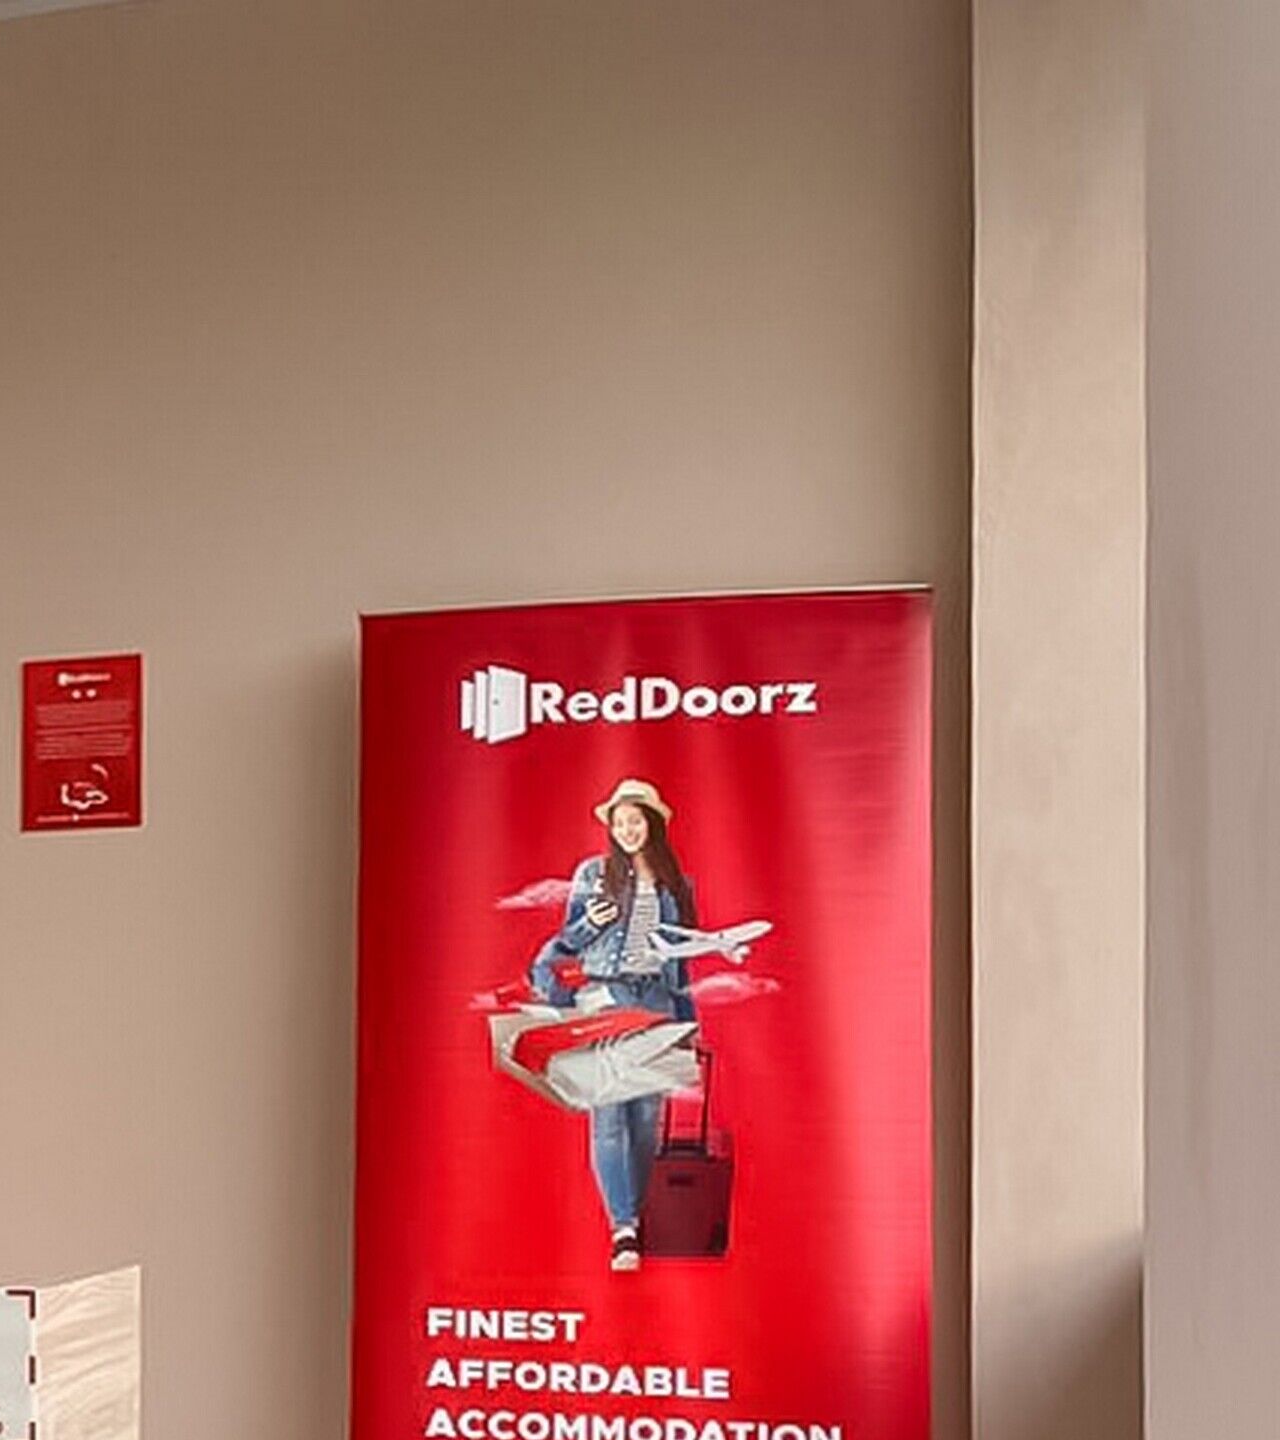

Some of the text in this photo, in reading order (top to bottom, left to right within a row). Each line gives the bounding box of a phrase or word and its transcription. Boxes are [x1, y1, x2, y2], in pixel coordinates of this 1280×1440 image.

[530, 675, 818, 724] RedDoorz
[426, 1306, 585, 1343] FINEST
[425, 1358, 731, 1400] AFFORDABLE
